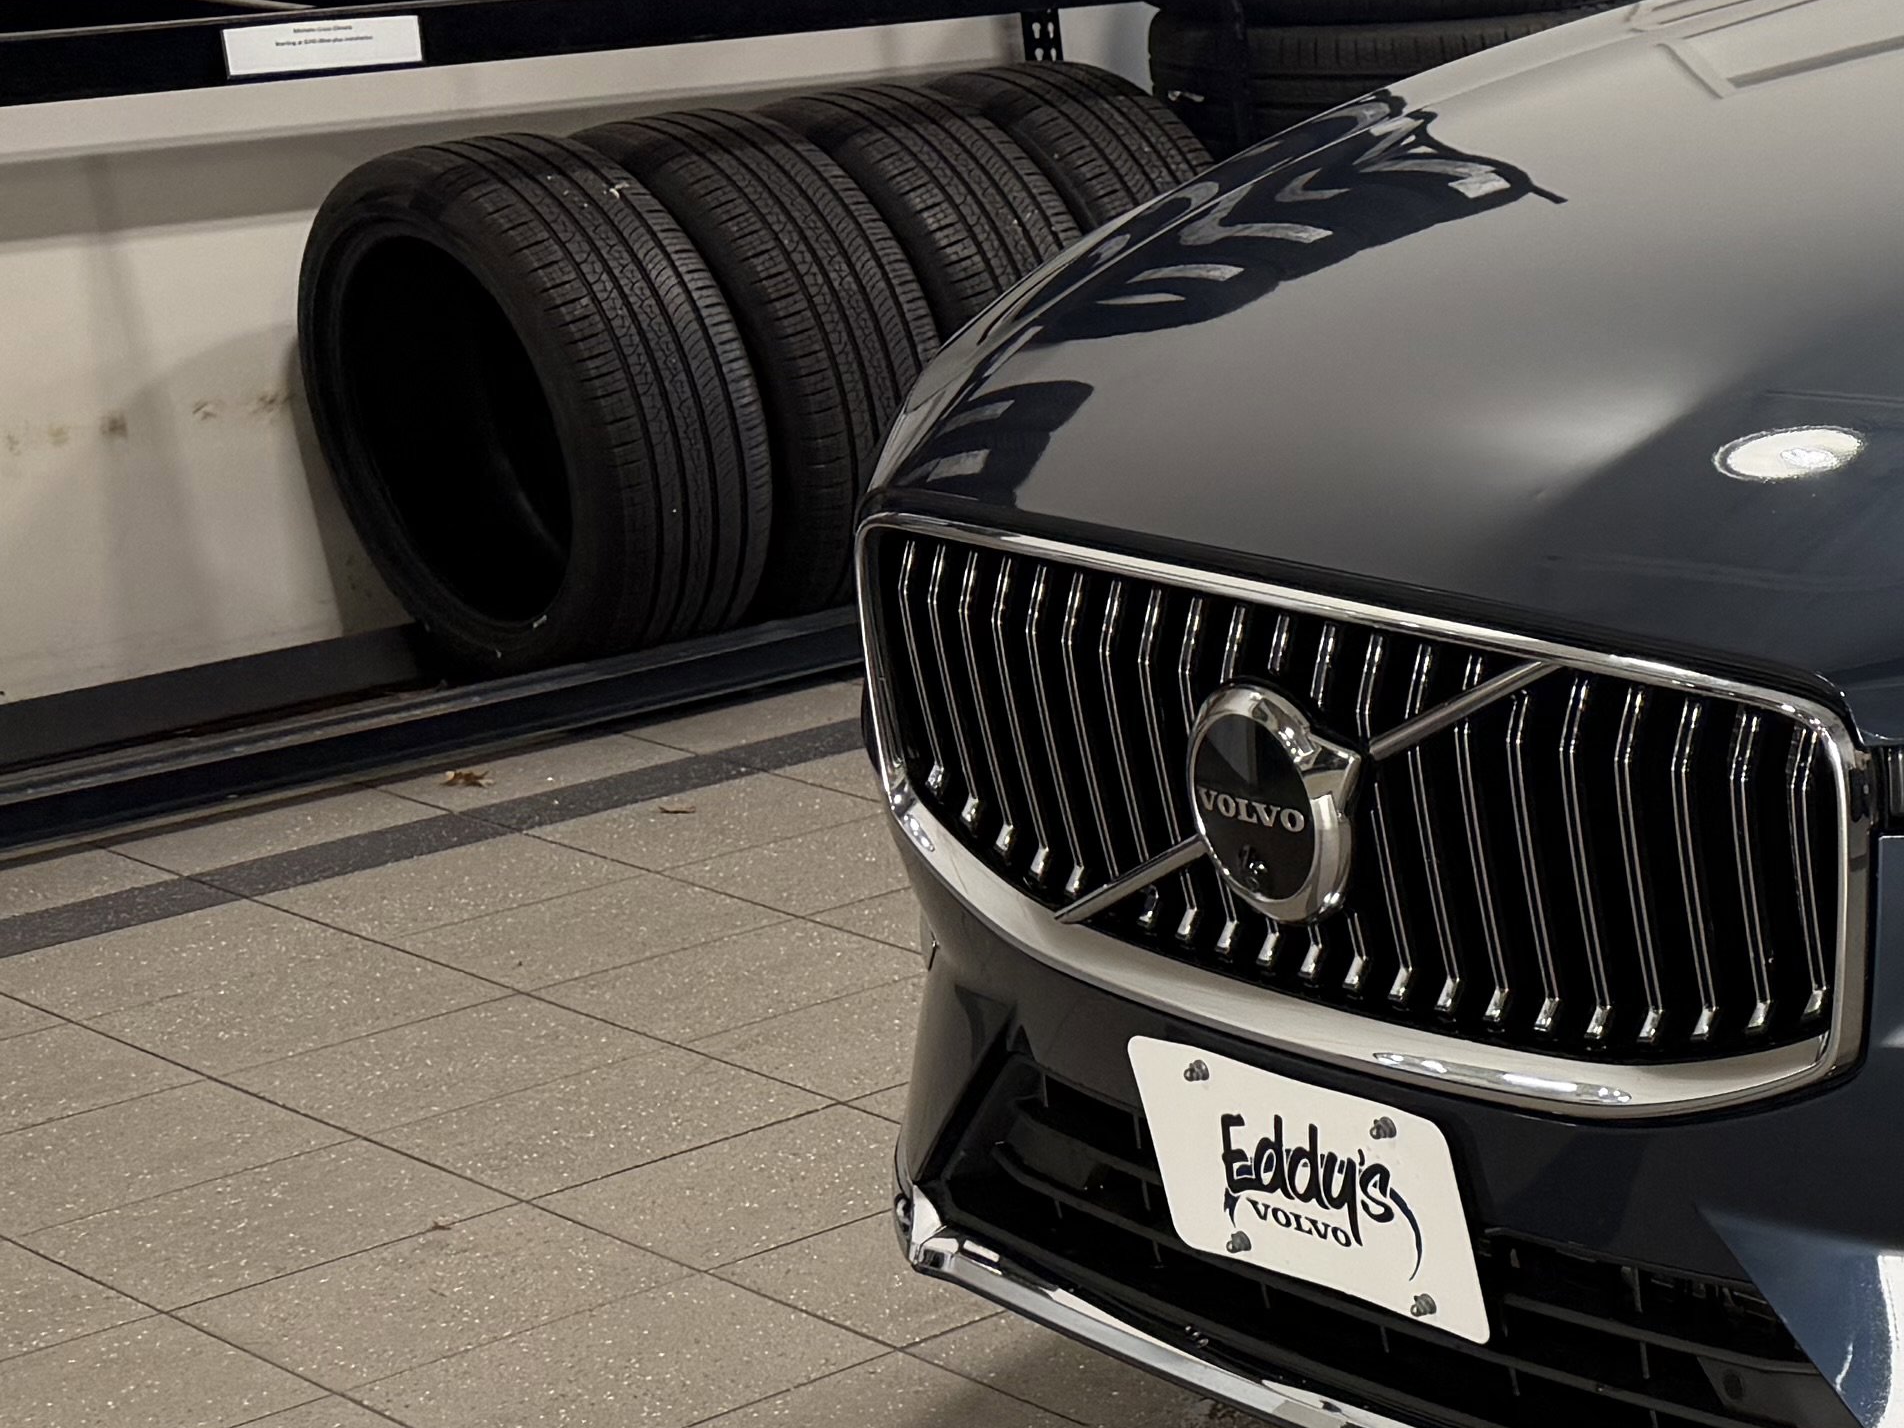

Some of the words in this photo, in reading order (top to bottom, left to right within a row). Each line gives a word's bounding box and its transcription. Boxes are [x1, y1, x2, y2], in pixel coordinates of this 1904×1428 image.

[1197, 785, 1305, 833] VOLVO
[1221, 1113, 1394, 1247] Eddy's
[1246, 1197, 1352, 1247] VOLVO
